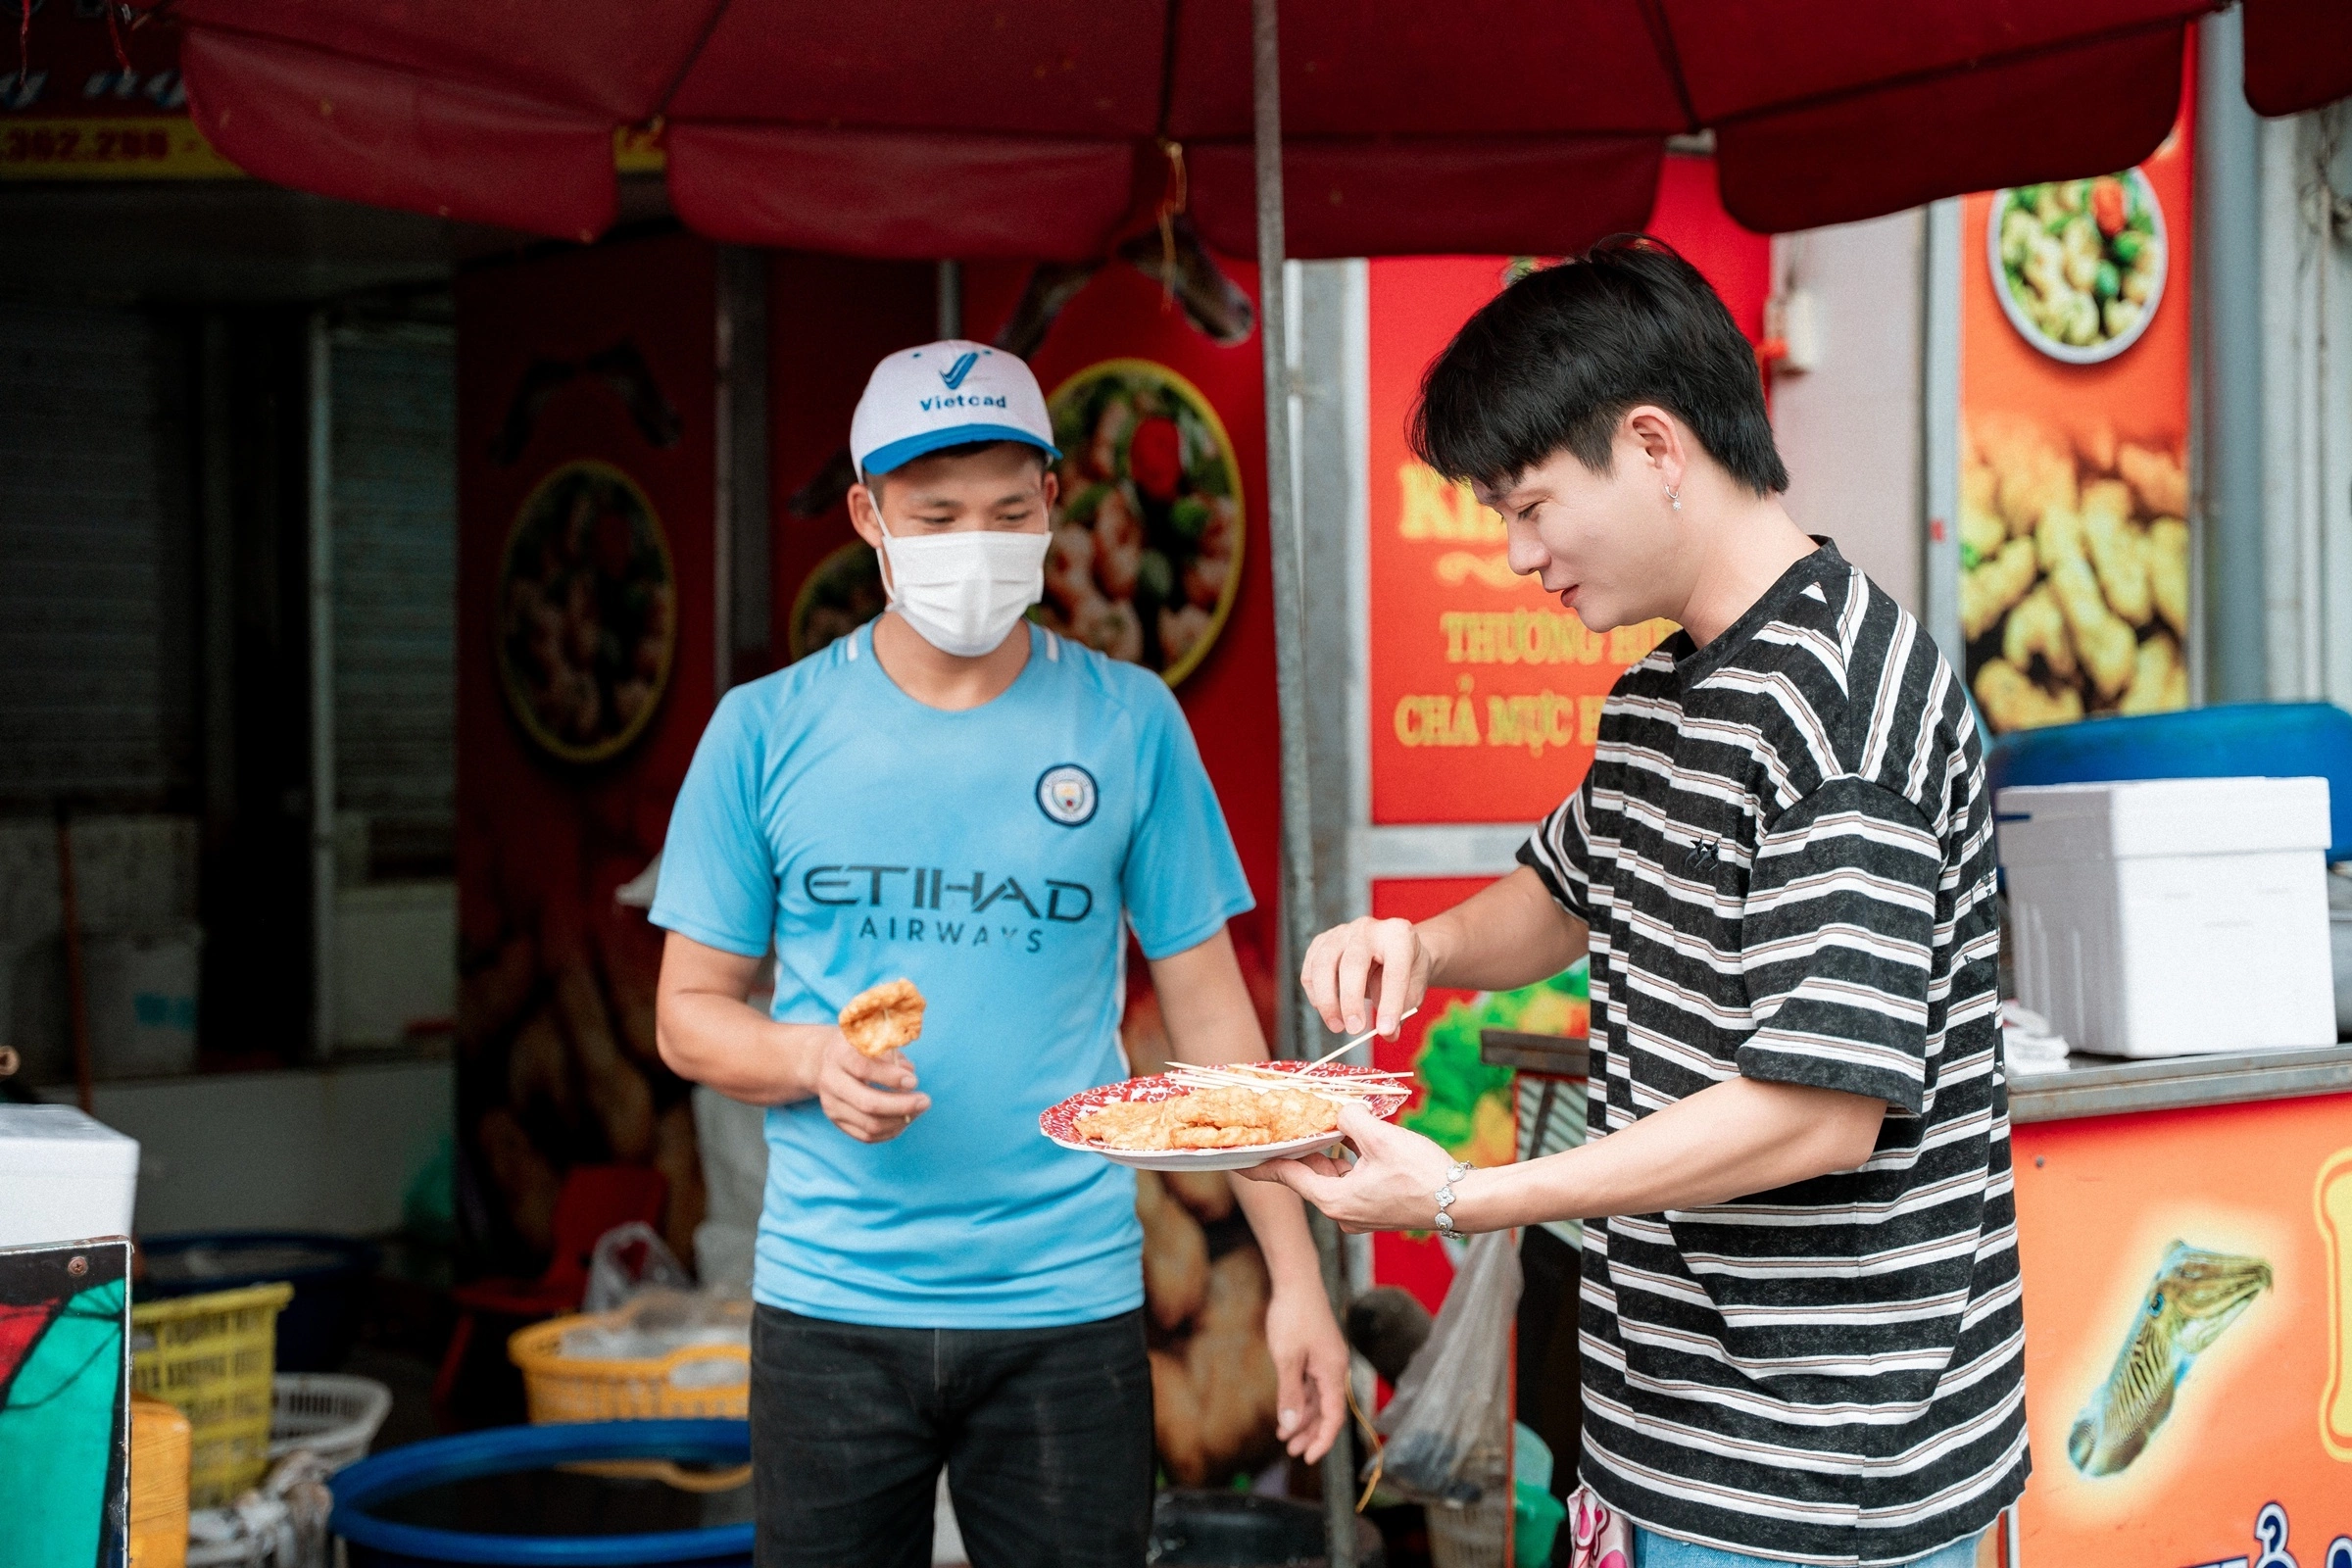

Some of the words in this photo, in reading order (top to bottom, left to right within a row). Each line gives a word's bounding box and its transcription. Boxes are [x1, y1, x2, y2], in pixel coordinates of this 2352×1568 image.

[919, 395, 1007, 412] Vietcad
[1394, 673, 1481, 747] CHẢ
[804, 864, 1094, 923] ETIHAD
[858, 916, 1045, 954] AIRWAYS
